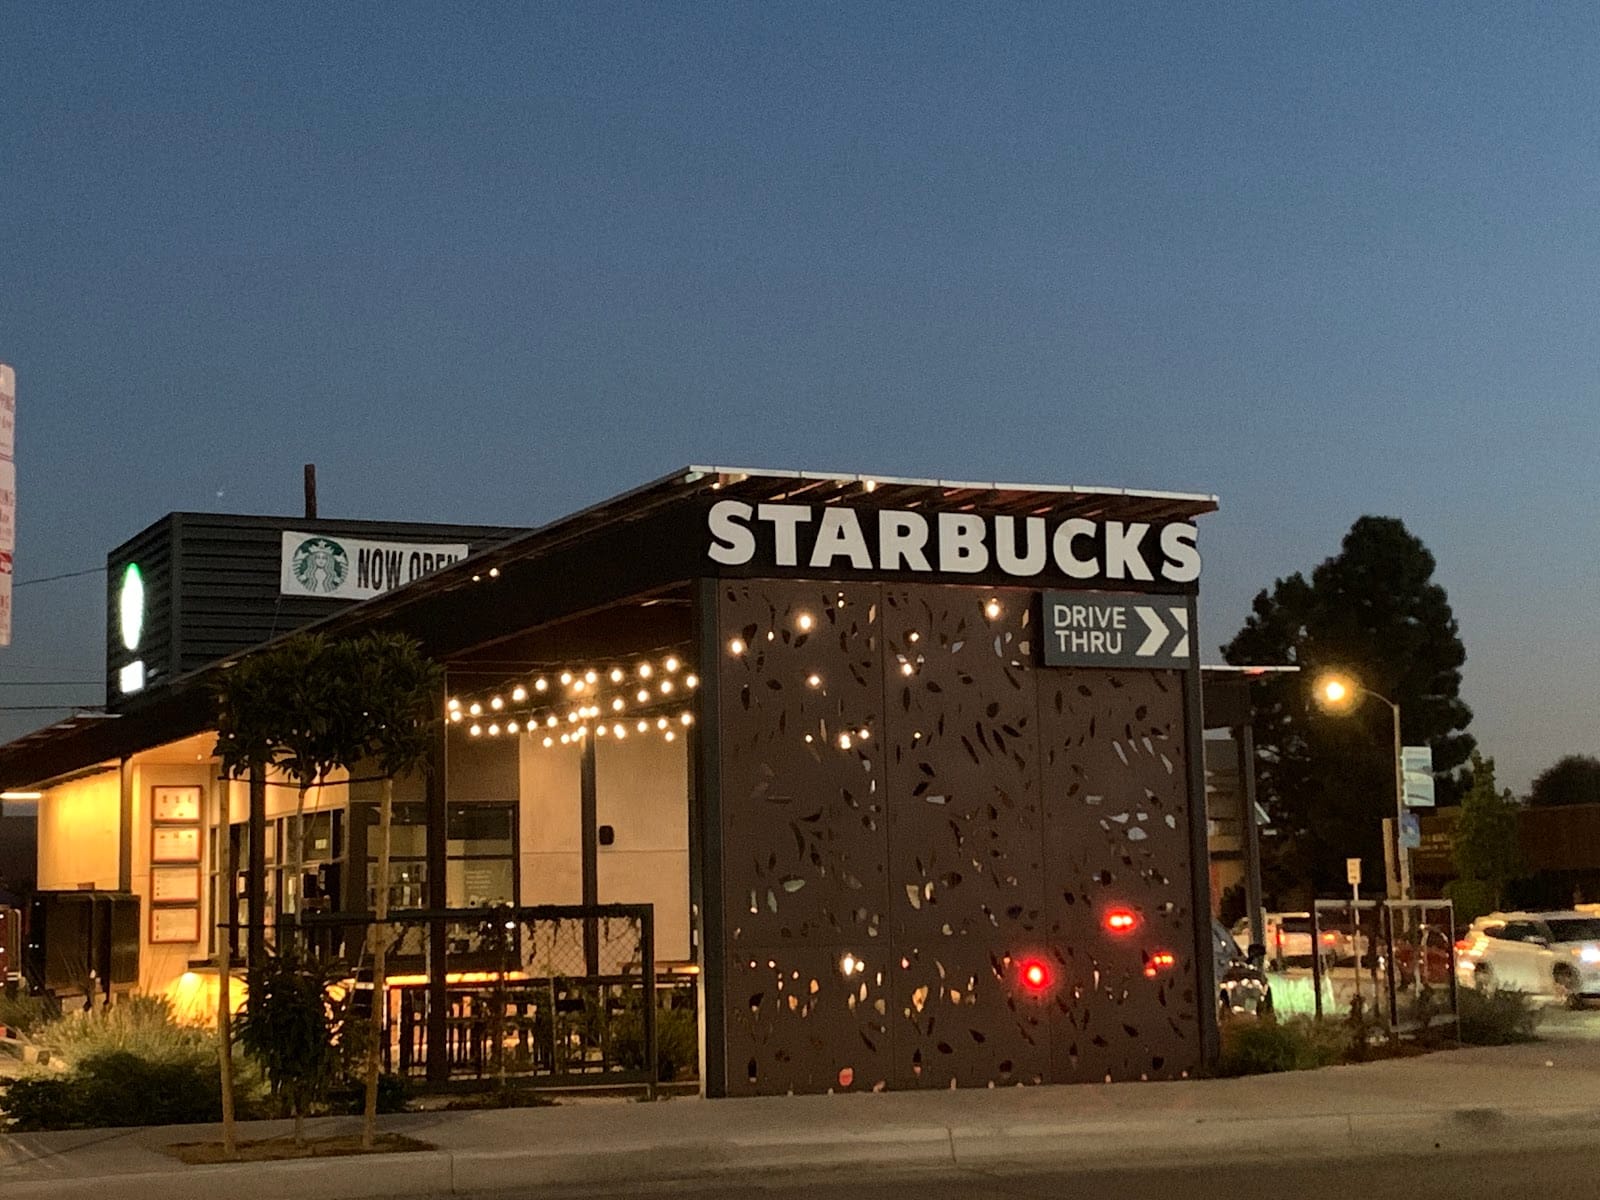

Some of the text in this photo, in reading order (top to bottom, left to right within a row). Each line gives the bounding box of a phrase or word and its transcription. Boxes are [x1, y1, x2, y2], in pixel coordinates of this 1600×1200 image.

[708, 500, 1202, 583] STARBUCKS
[357, 548, 404, 591] NOW
[1054, 604, 1127, 629] DRIVE
[1054, 630, 1122, 654] THRU
